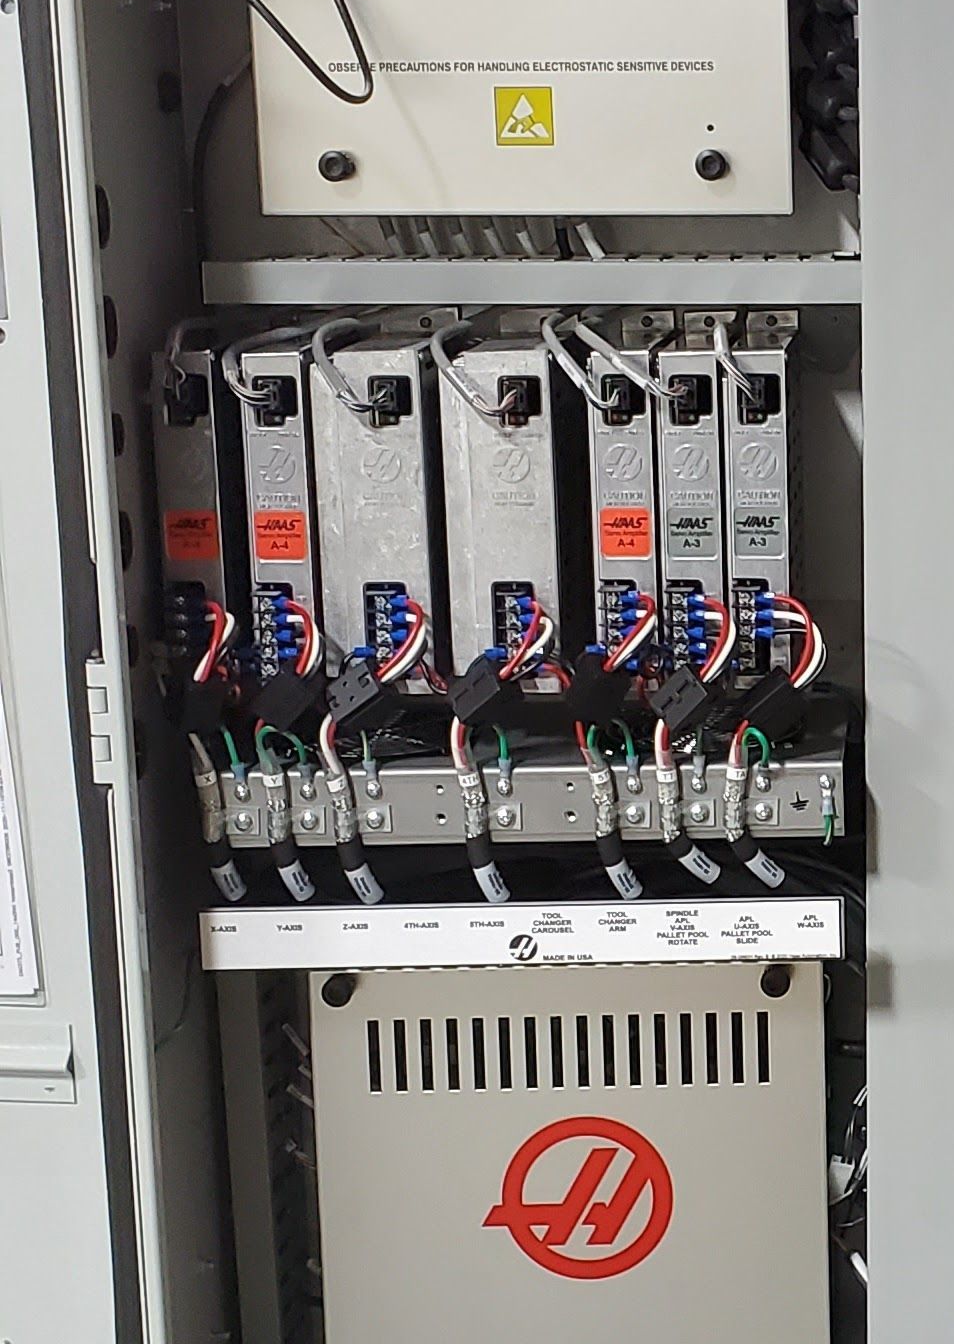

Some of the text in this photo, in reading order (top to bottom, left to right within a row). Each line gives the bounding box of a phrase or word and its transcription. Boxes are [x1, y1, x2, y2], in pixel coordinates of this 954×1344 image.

[327, 60, 715, 73] OBSERE PRECAUTIONS FOR HANDLING ELECTROSTATIC SENSITIVE DEVICES
[256, 519, 302, 531] HAAS
[603, 516, 649, 530] HAAS
[670, 516, 714, 530] HAAS
[736, 515, 781, 528] HAAS
[270, 541, 289, 550] A-4
[617, 538, 635, 548] A-4
[682, 538, 701, 548] A-3
[748, 537, 767, 547] A-3
[203, 774, 213, 783] X
[270, 776, 279, 785] Y
[541, 912, 563, 920] TOOL
[606, 911, 628, 919] TOOL
[738, 915, 755, 923] APL
[802, 914, 819, 922] APL
[210, 920, 505, 933] X-AXIS Y-AXIS Z-AXIS 4TH-AXIS 5TH-AXIS
[532, 919, 573, 927] CHANGER
[597, 918, 637, 926] CHANGER
[733, 922, 760, 930] U-AXIS
[797, 921, 825, 929] W-AXIS
[531, 927, 575, 935] CAROUSEL
[608, 925, 627, 933] ARM
[720, 929, 774, 937] PALLET POOL
[656, 930, 710, 939] PALLET POOL
[667, 938, 699, 946] ROTATE
[735, 937, 759, 945] SLIDE
[542, 954, 566, 962] MADE
[576, 953, 594, 961] USA
